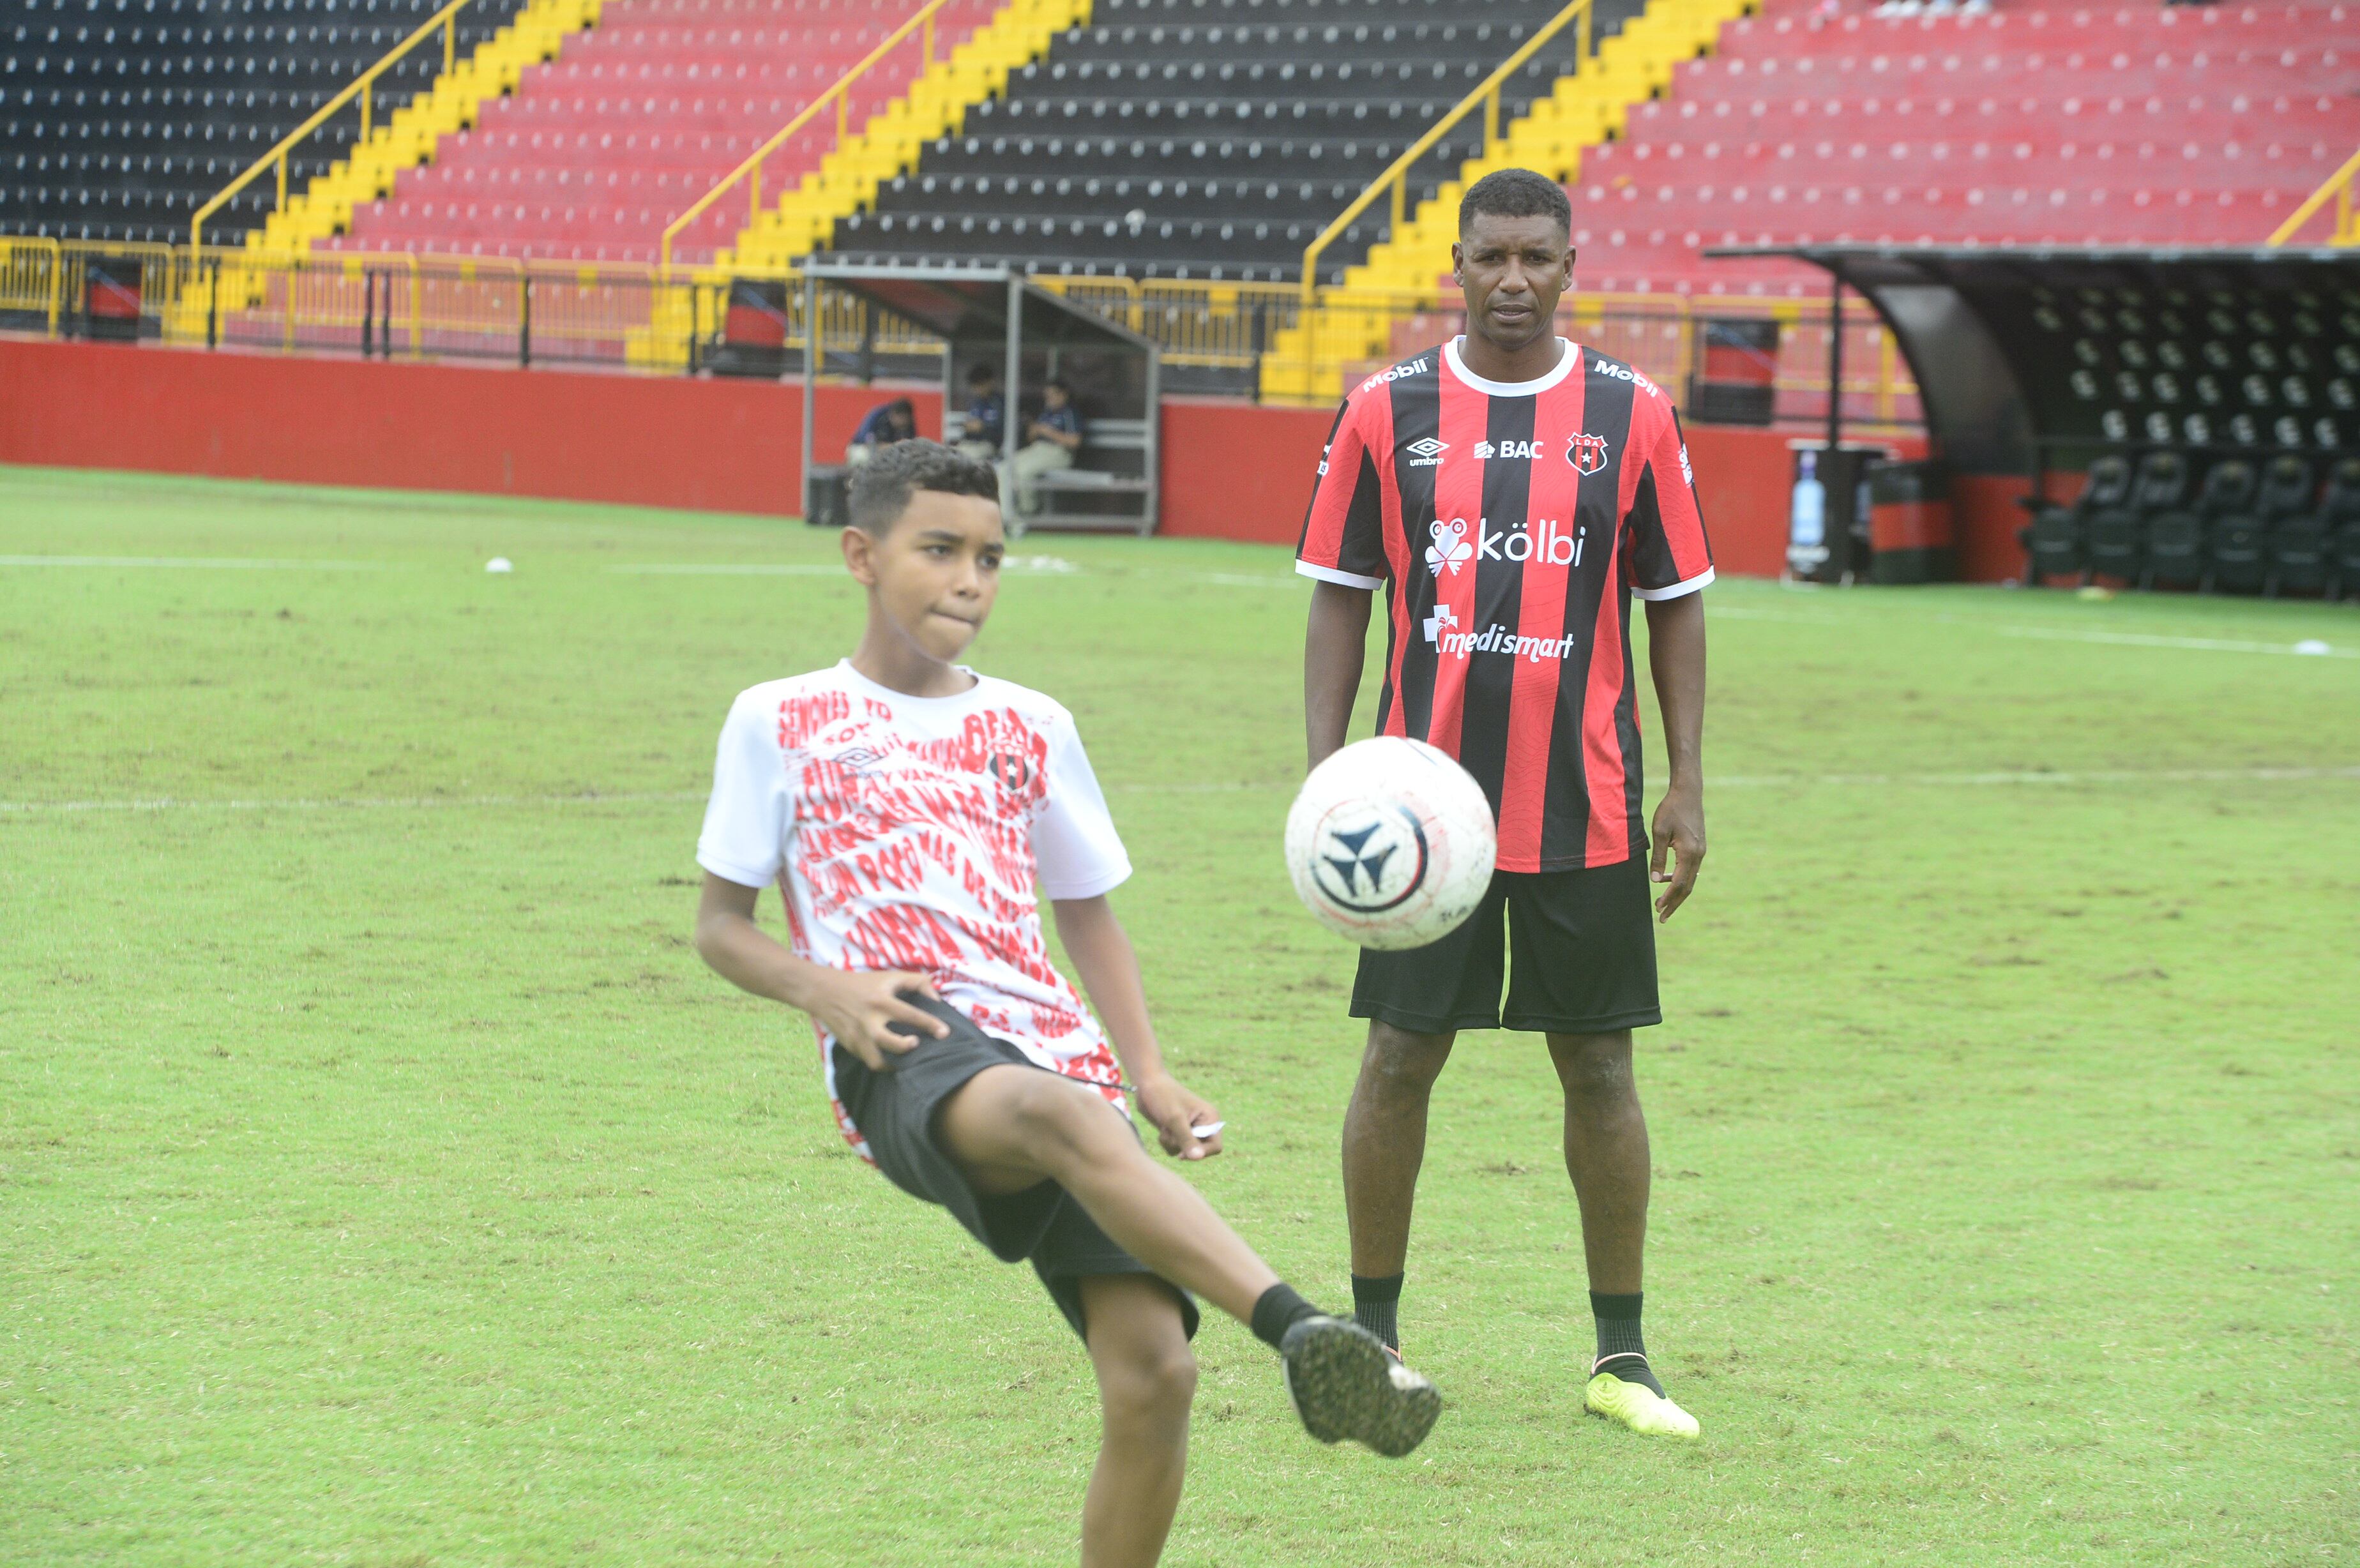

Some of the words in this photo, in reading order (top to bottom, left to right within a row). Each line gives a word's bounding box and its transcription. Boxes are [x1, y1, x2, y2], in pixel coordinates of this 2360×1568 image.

[1363, 358, 1428, 393] Mobil
[1594, 359, 1658, 397] Mobil
[1409, 456, 1444, 466] umbro
[1500, 441, 1544, 459] BAC
[1476, 518, 1586, 567] kölbi
[1442, 623, 1574, 663] medismart
